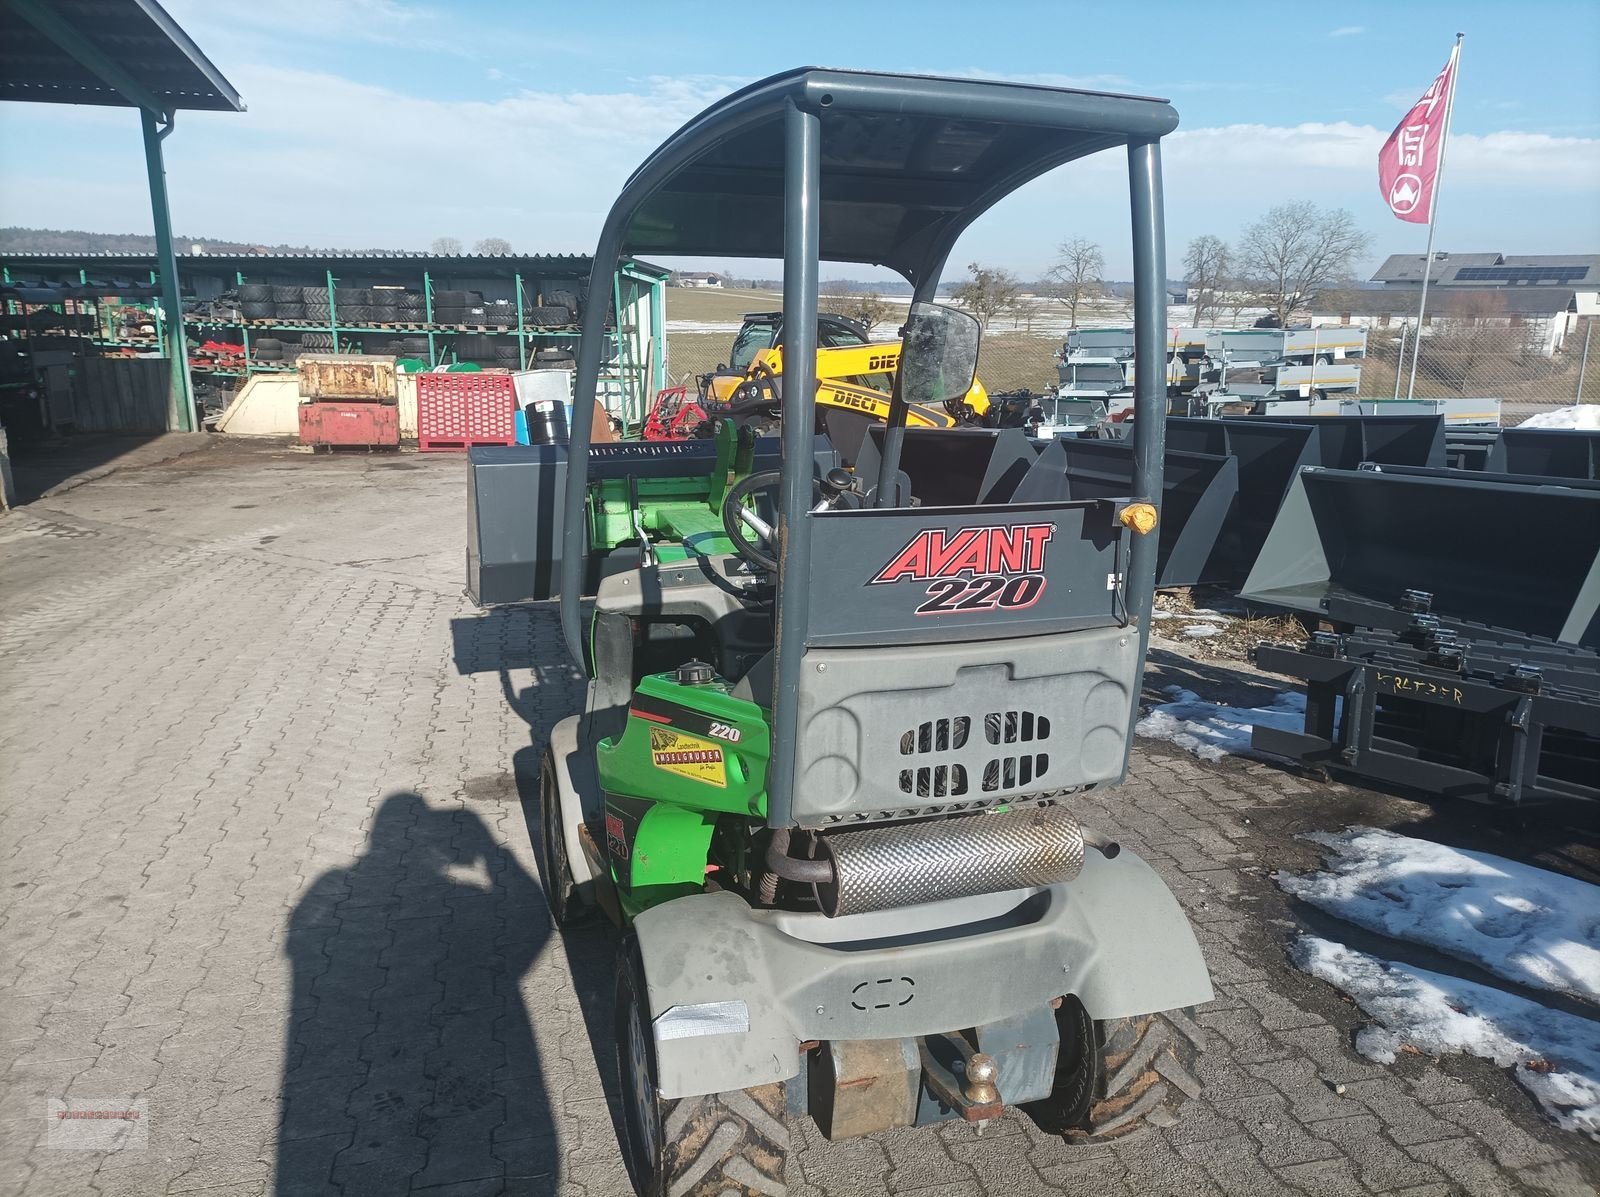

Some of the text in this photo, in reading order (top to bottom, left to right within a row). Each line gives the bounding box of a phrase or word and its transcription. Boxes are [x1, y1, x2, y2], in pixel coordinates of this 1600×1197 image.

[833, 390, 878, 412] DIECI
[864, 523, 1055, 586] AVANT
[914, 575, 1047, 616] 220
[709, 722, 741, 743] 220
